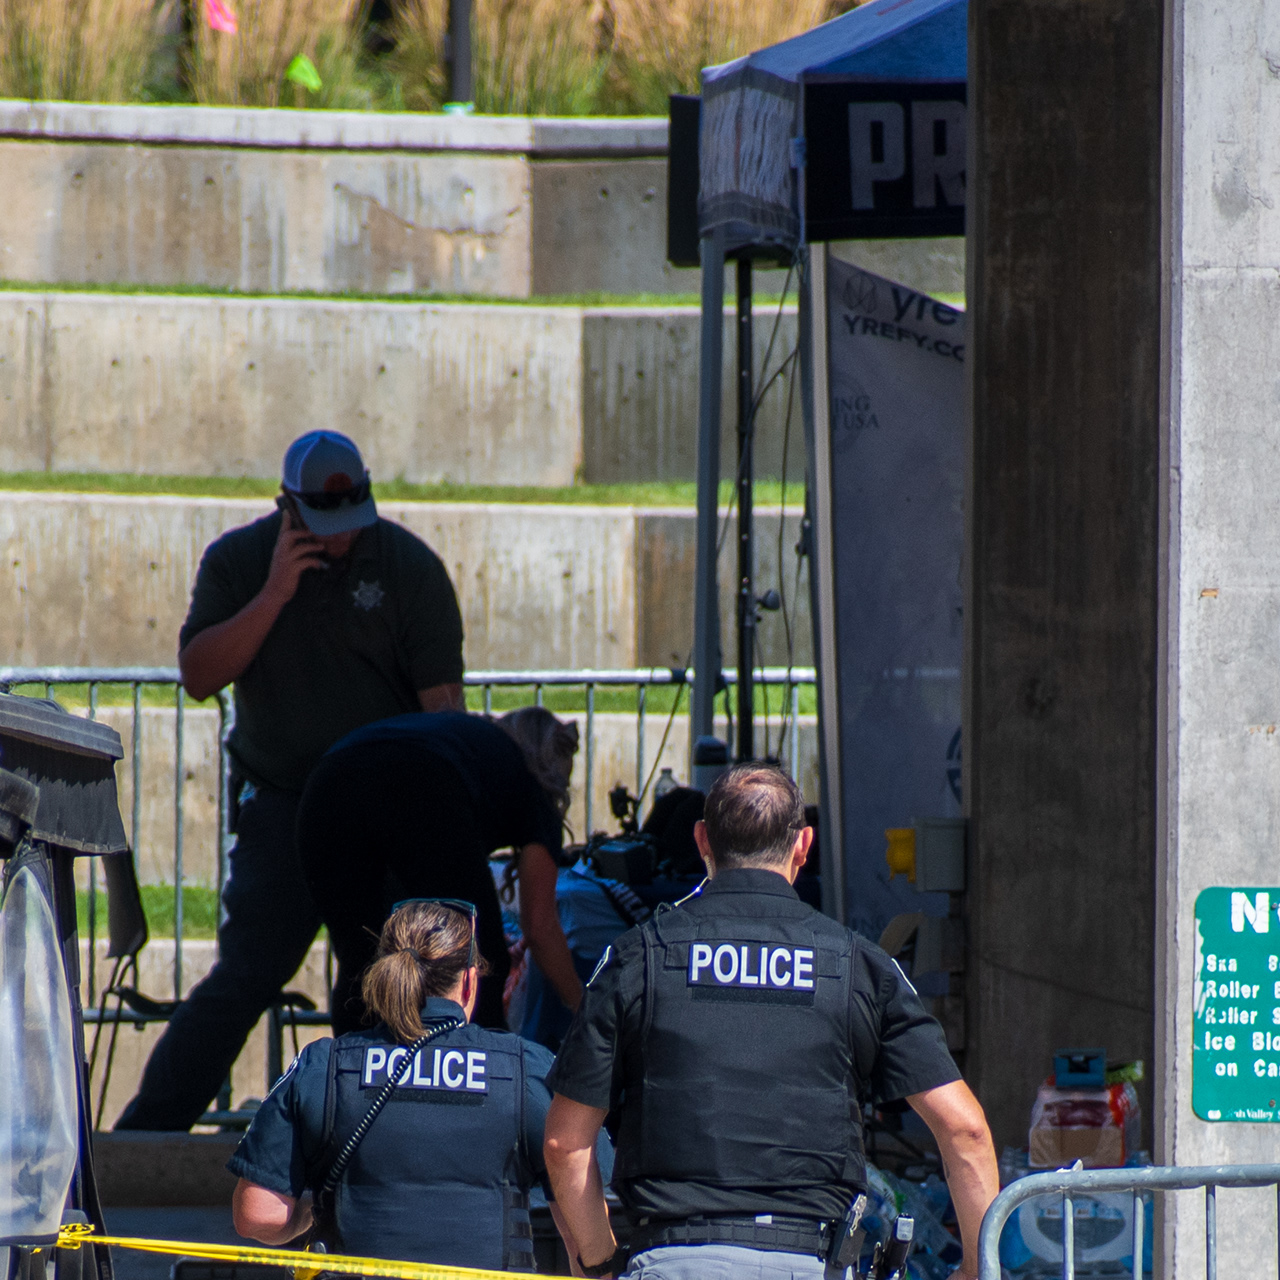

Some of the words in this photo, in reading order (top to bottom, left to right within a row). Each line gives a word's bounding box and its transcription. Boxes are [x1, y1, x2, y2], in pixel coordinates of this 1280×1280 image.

[690, 942, 815, 989] POLICE
[1205, 980, 1260, 999] Roller
[1205, 1031, 1236, 1052] Ice
[364, 1046, 486, 1090] POLICE
[1214, 1061, 1239, 1078] on
[1246, 1107, 1274, 1121] Valley
